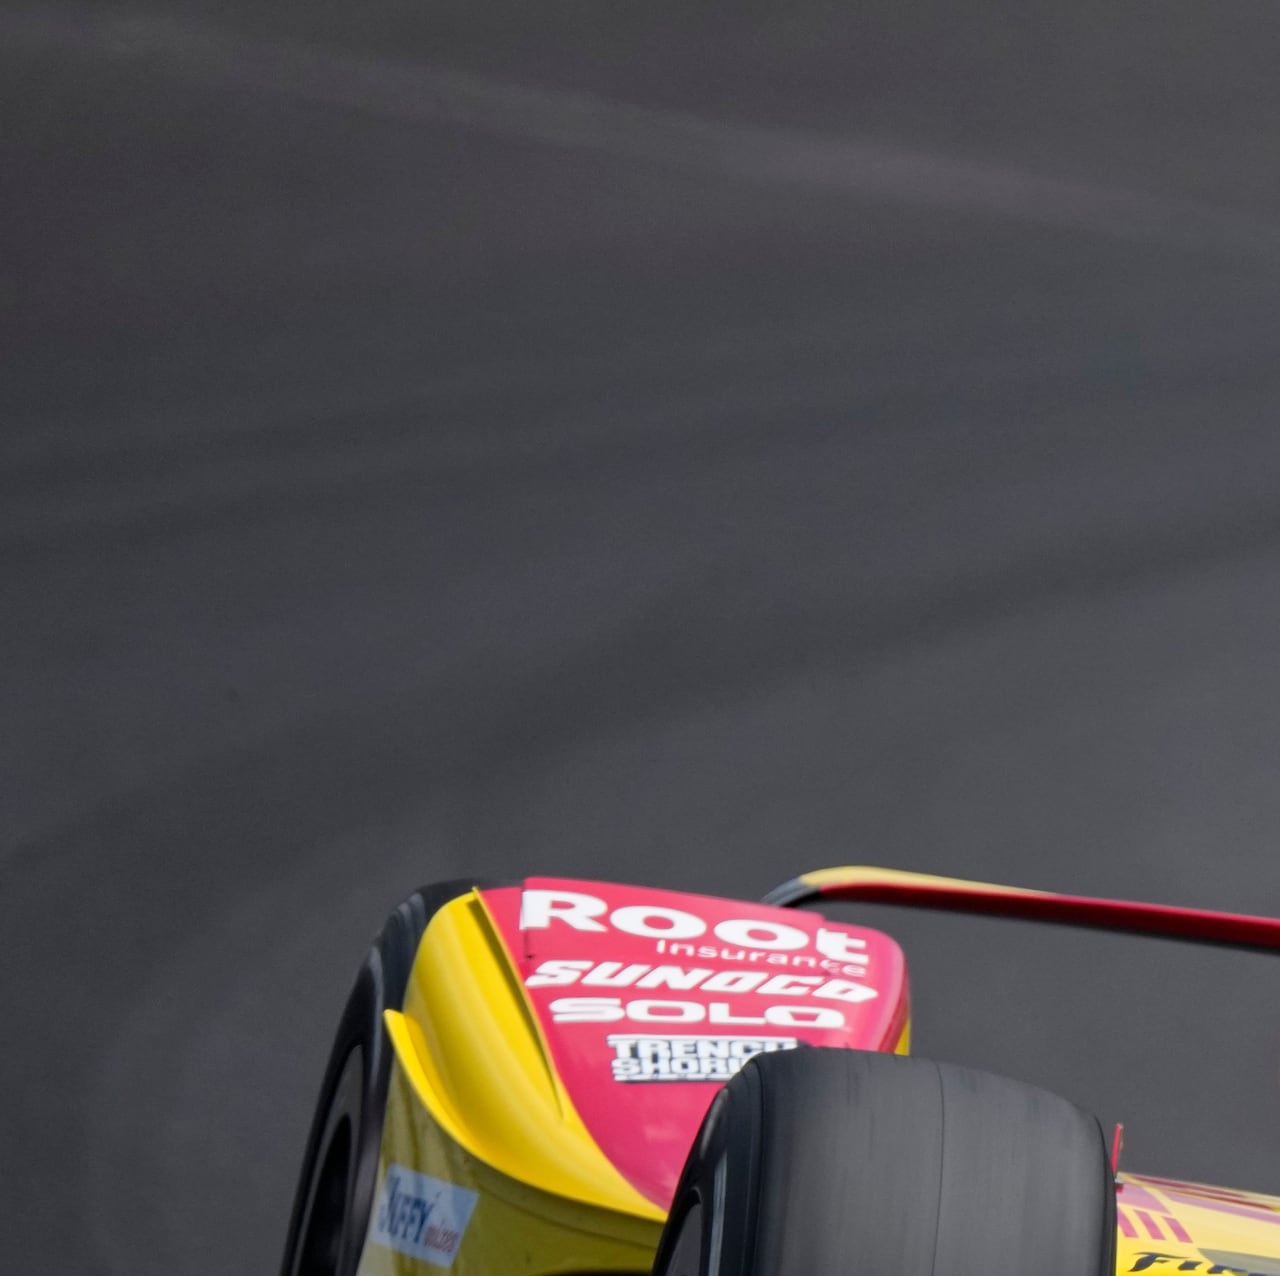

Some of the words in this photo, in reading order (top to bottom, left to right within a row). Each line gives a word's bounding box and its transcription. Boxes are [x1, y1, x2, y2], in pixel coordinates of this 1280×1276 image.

[525, 959, 879, 1002] SUNOCO
[549, 997, 846, 1029] SOLO
[611, 1058, 747, 1075] SHORI
